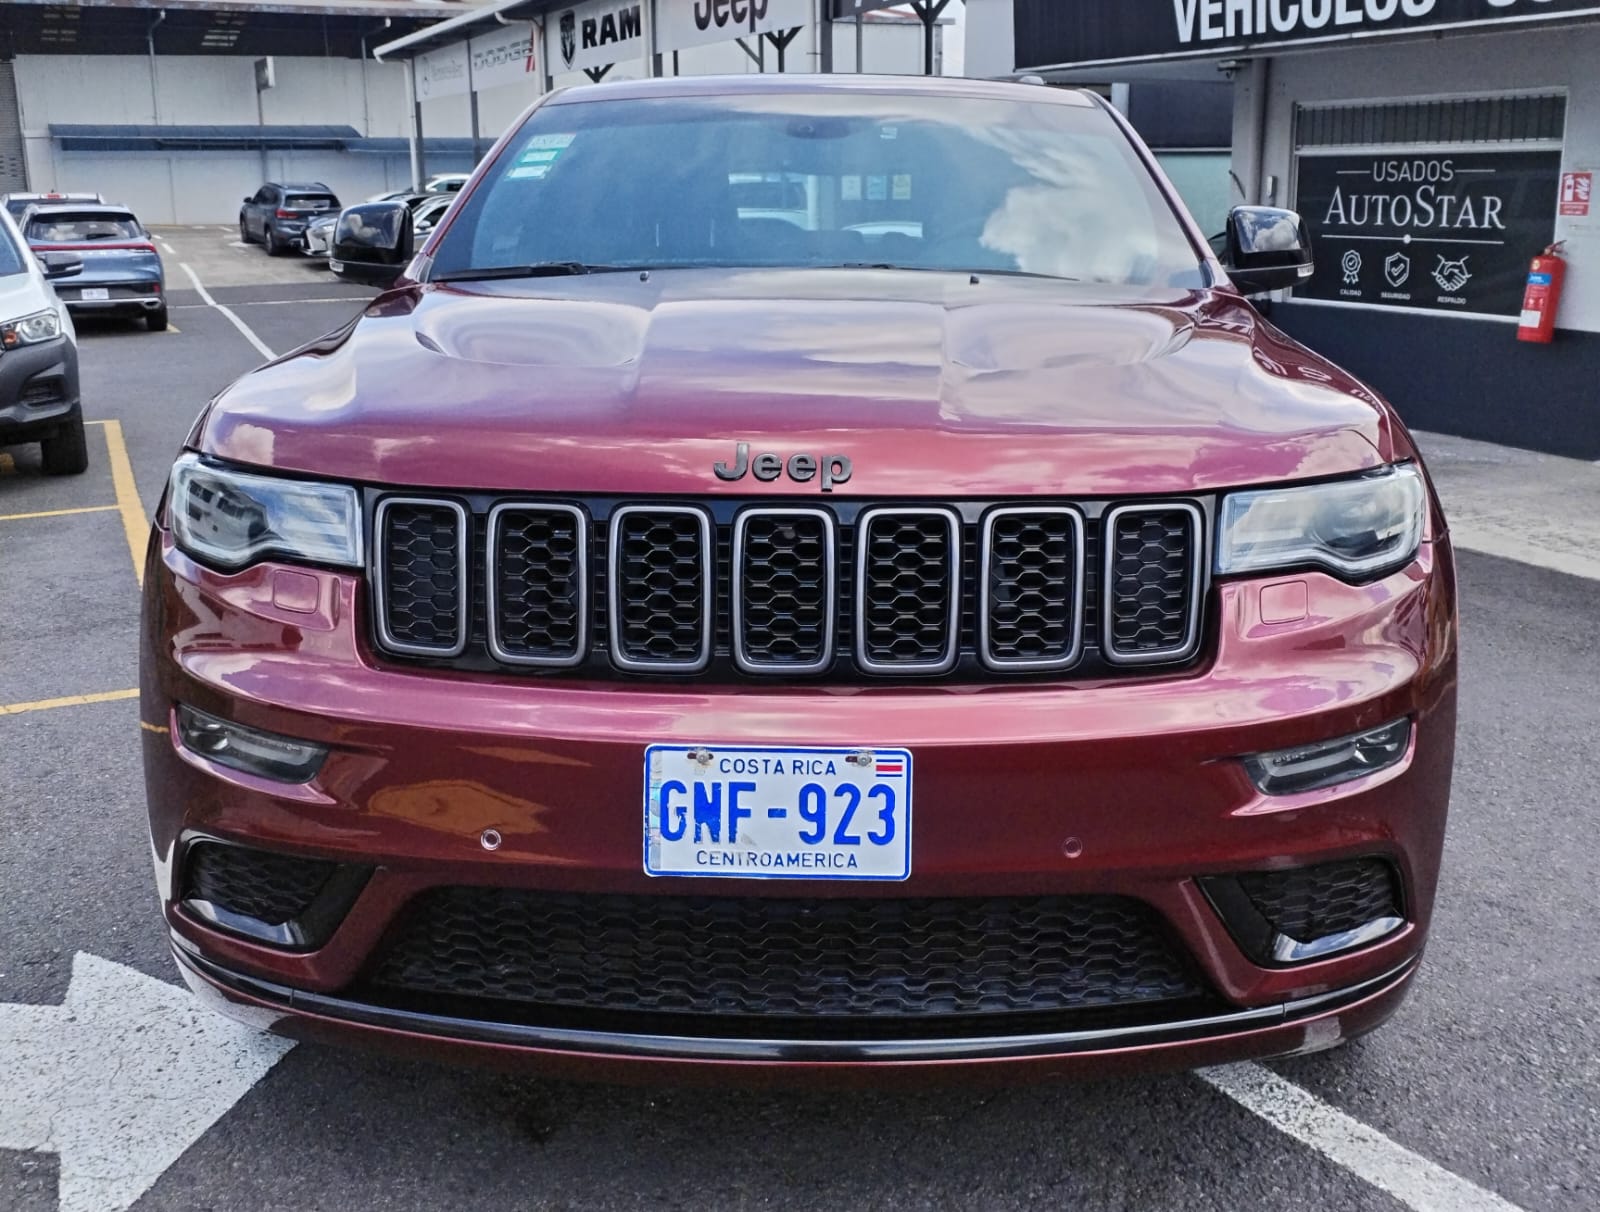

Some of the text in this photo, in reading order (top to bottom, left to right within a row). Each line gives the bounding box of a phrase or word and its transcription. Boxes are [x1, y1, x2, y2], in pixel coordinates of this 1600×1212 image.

[582, 5, 641, 49] RAM
[1173, 0, 1436, 43] VEHIC
[1372, 160, 1454, 182] USADOS
[713, 443, 853, 492] Jeep
[719, 758, 837, 776] COSTA RICA
[696, 850, 858, 868] CENTROAMERICA
